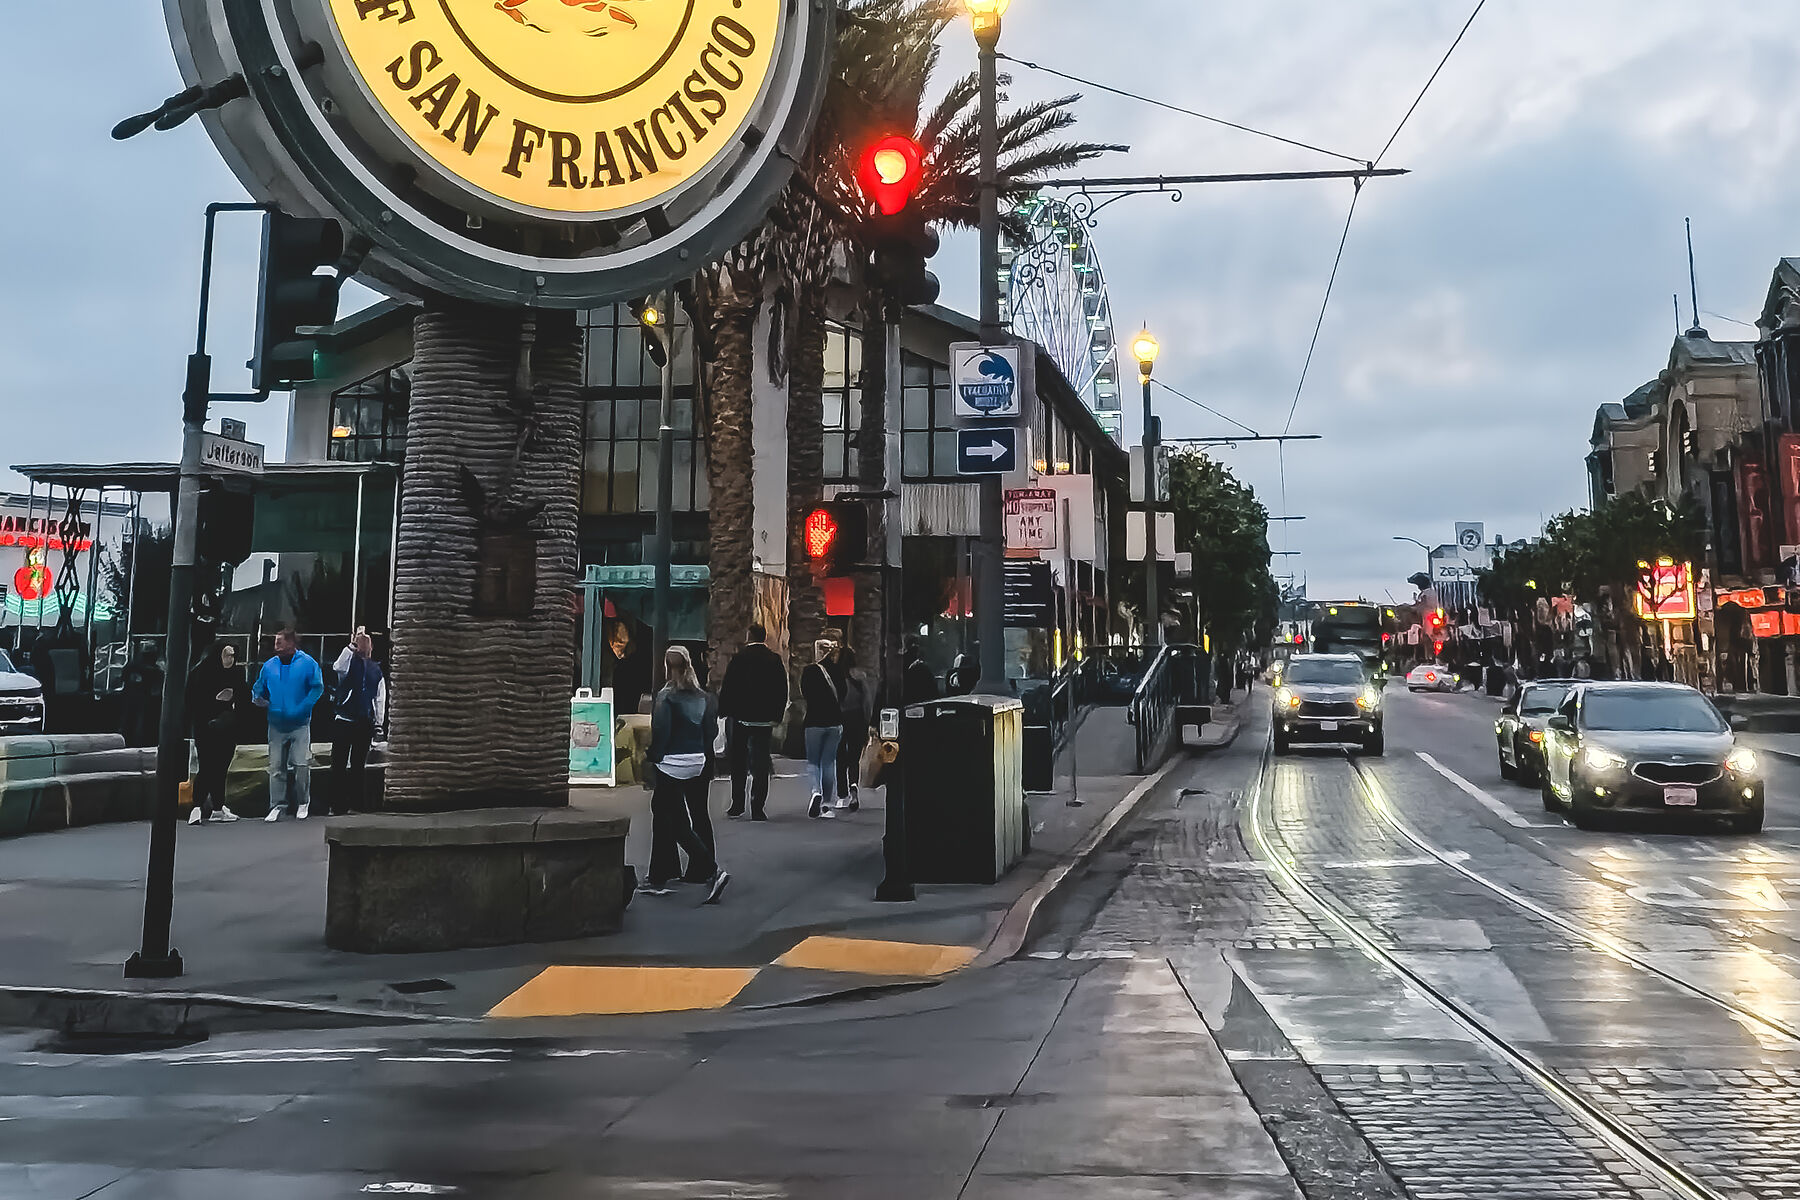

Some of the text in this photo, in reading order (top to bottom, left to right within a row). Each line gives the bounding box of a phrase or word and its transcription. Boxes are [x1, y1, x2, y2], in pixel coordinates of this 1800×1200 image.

[384, 40, 501, 156] SAN
[501, 15, 756, 190] FRANCISCO
[206, 441, 259, 469] Jefferson
